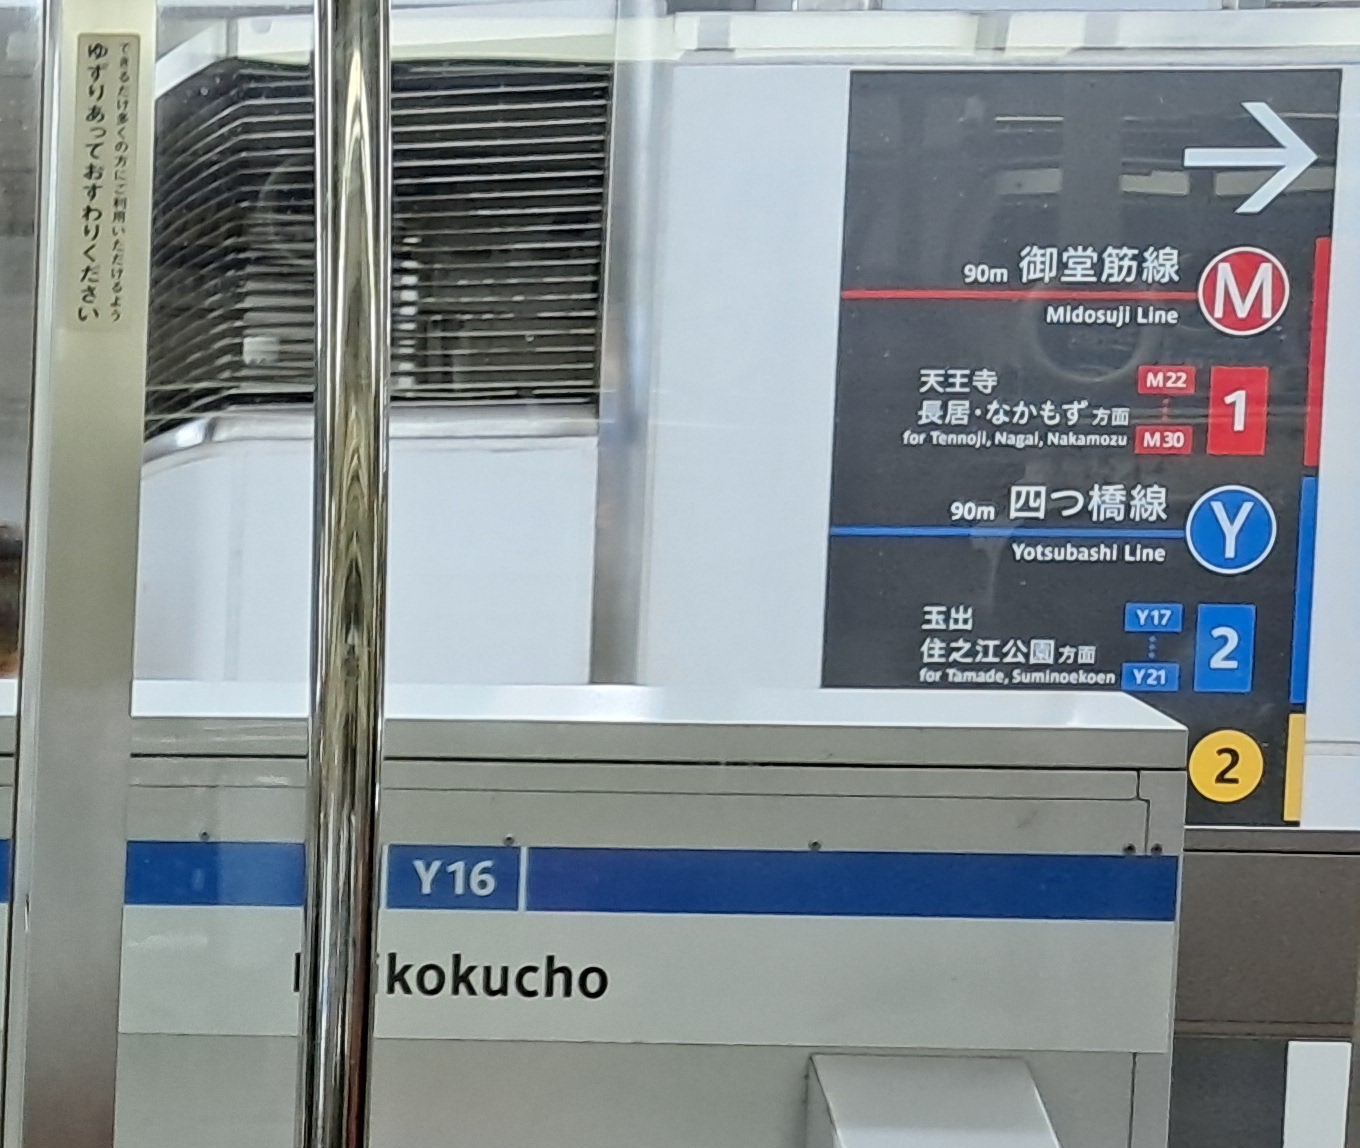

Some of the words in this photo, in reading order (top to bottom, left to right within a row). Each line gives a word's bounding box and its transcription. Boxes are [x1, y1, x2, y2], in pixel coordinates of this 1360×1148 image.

[78, 42, 108, 322] ゆずりあっておすわりください
[963, 265, 1009, 284] 90m
[1019, 245, 1180, 285] 御堂筋線
[1213, 262, 1273, 319] M
[1046, 305, 1131, 327] Midosuji
[1137, 306, 1179, 325] Line
[918, 368, 999, 395] 天王寺
[1146, 371, 1188, 388] M22
[1223, 389, 1247, 432] 1
[902, 430, 927, 446] for
[929, 430, 993, 449] Tennoji,
[994, 431, 1043, 449] Nagai,
[1047, 431, 1128, 447] Nakamozu
[1143, 431, 1185, 448] M30
[950, 502, 995, 521] 90m
[1009, 484, 1168, 523] 四つ橋線
[1210, 501, 1255, 559] Y
[1012, 543, 1118, 562] Yotsubashi
[1124, 545, 1166, 562] Line
[921, 605, 973, 631] 玉出
[1136, 609, 1172, 626] Y17
[1209, 627, 1240, 669] 2
[919, 669, 944, 684] for
[946, 669, 1009, 686] Tamade,
[1012, 670, 1116, 685] Suminoekoen
[1133, 669, 1167, 686] Y21
[1214, 747, 1240, 784] 2
[412, 859, 497, 897] Y16
[292, 952, 608, 999] kokucho
